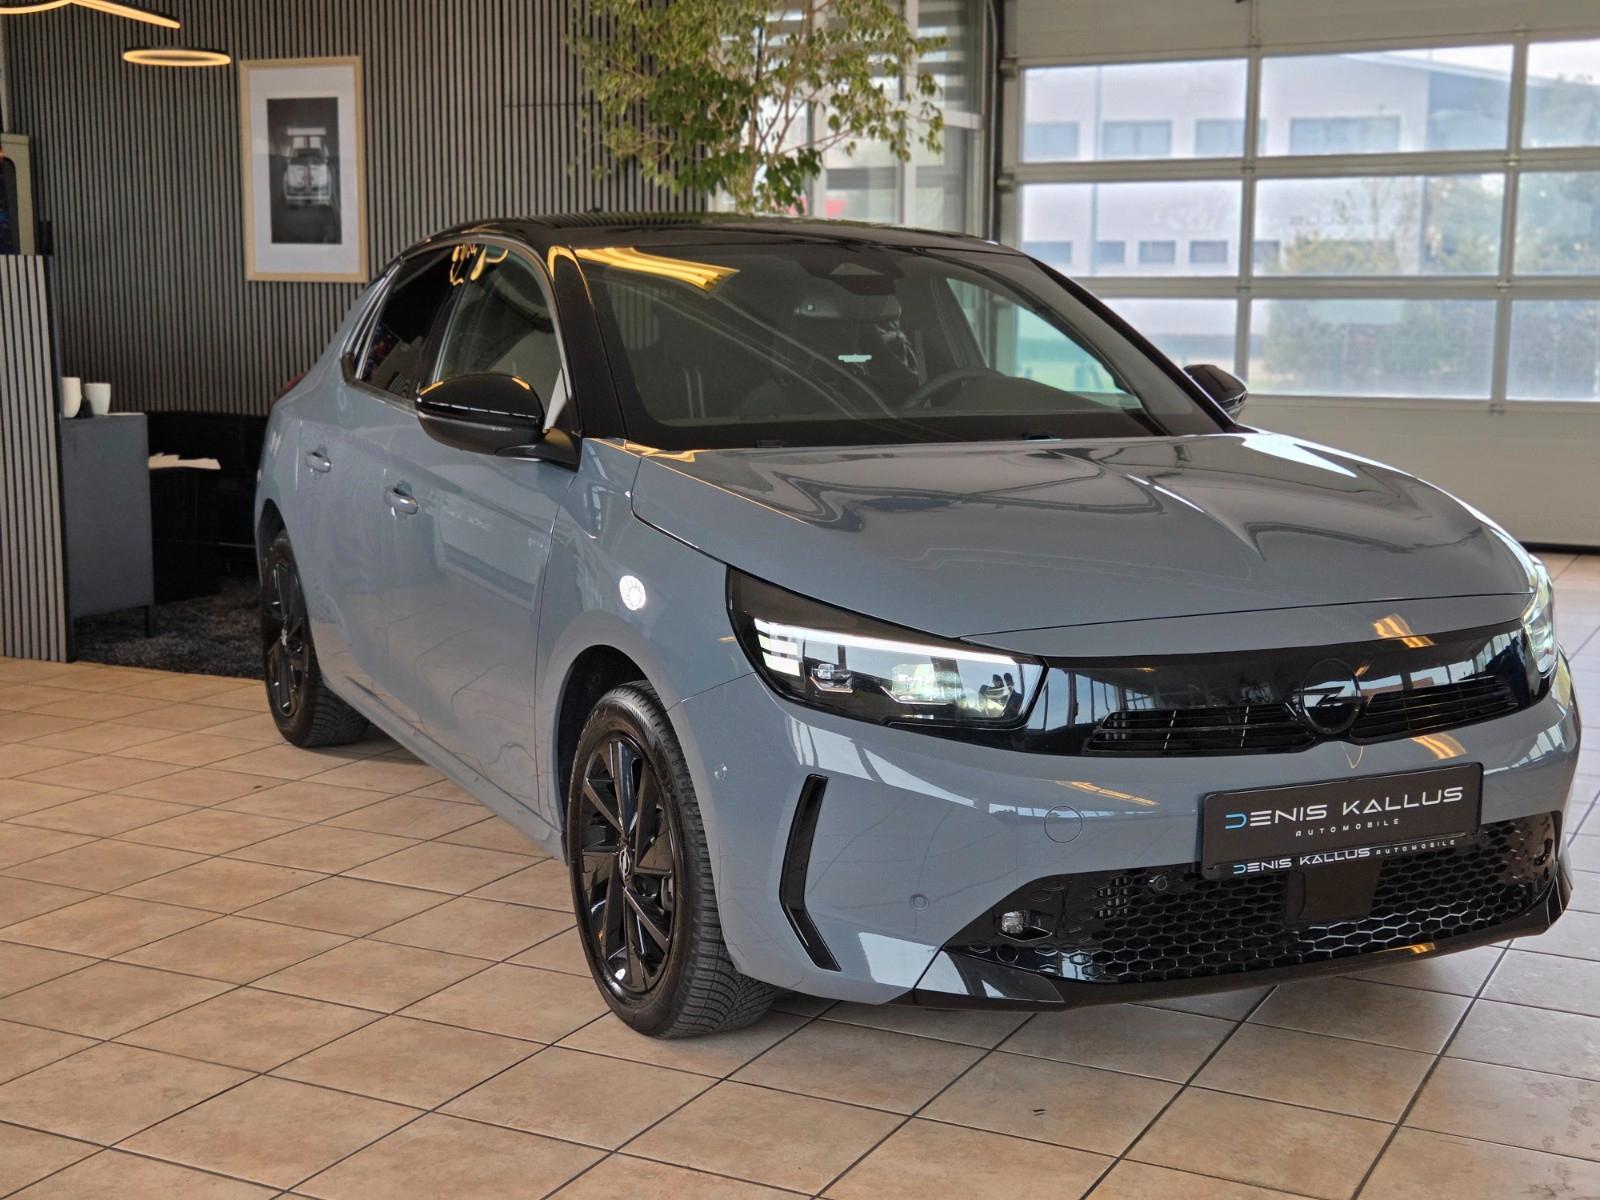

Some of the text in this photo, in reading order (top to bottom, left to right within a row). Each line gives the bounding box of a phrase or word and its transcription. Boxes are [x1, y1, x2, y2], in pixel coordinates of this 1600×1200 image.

[1225, 786, 1463, 829] DENIS KALLUS
[1295, 818, 1399, 837] AUTOMOBILE
[1233, 839, 1455, 875] DENIS KALLUS AUTOMOBILE
